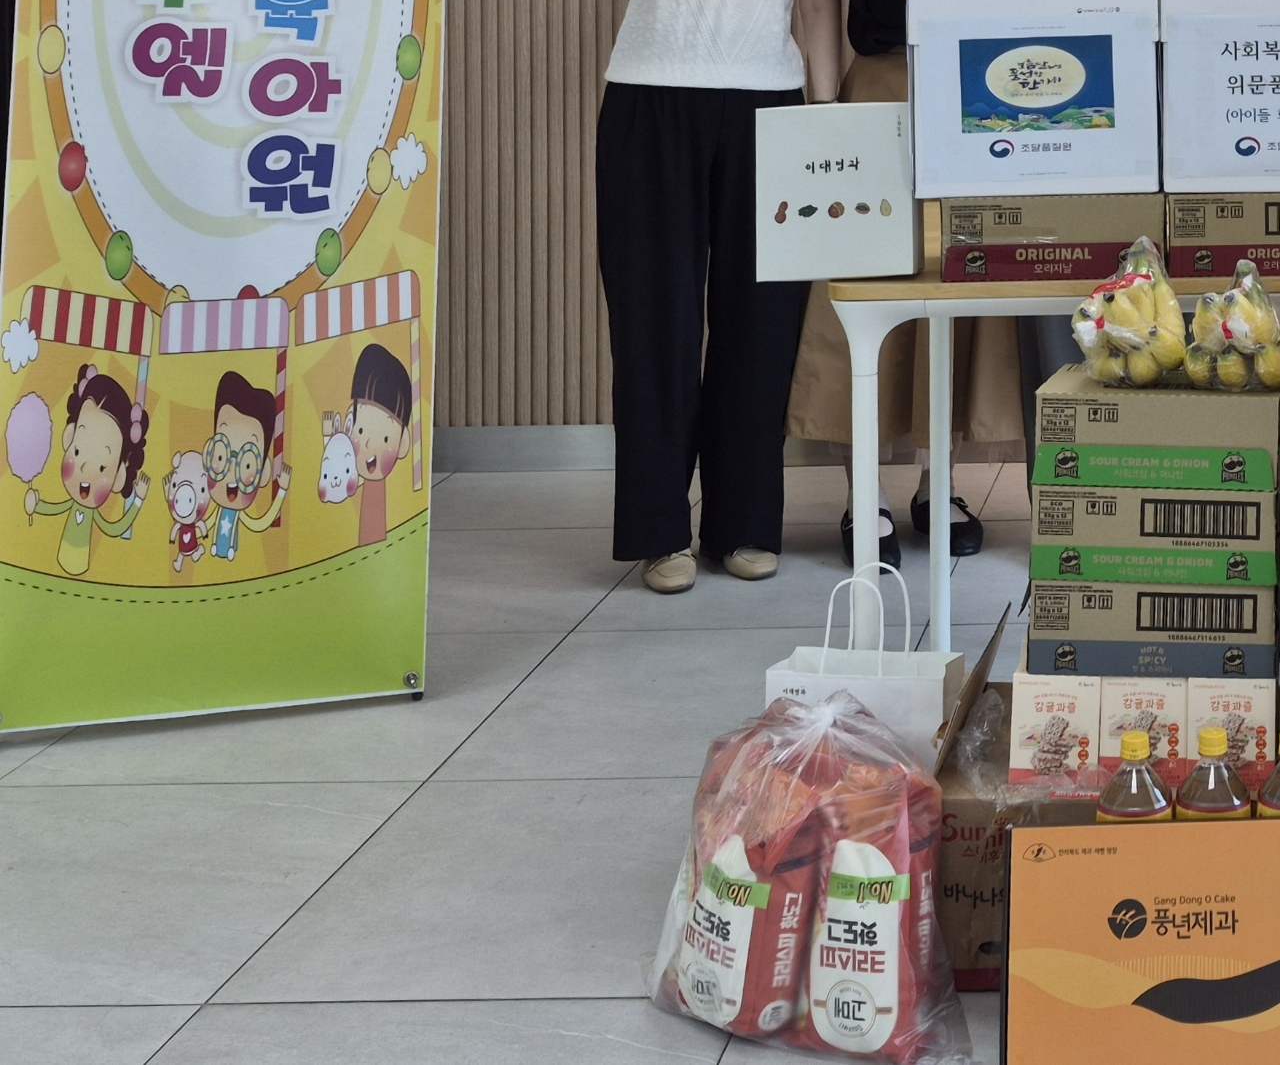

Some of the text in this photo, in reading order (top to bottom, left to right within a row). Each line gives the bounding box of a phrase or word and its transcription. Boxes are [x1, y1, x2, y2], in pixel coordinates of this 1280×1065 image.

[1226, 108, 1271, 123] (아이들
[1020, 142, 1073, 153] 조달품질원
[1016, 248, 1092, 261] ORIGINAL
[1034, 263, 1072, 274] 오리지날
[1089, 457, 1118, 466] SOUR
[1122, 457, 1160, 467] CREAM
[1173, 459, 1210, 469] ONION
[1171, 540, 1229, 548] 18886467105354
[1092, 555, 1122, 565] SOUR
[1125, 556, 1164, 566] CREAM
[1177, 557, 1213, 567] ONION
[1140, 647, 1156, 655] HOT
[1138, 655, 1167, 666] SPICY
[716, 880, 752, 907] No.1
[856, 881, 893, 904] No.1
[1154, 894, 1236, 907] Gang Dong O Cake
[1151, 909, 1239, 940] 풍년제과
[827, 917, 877, 946] 핫도그
[820, 944, 886, 974] 크리스피
[834, 998, 867, 1022] 고메
